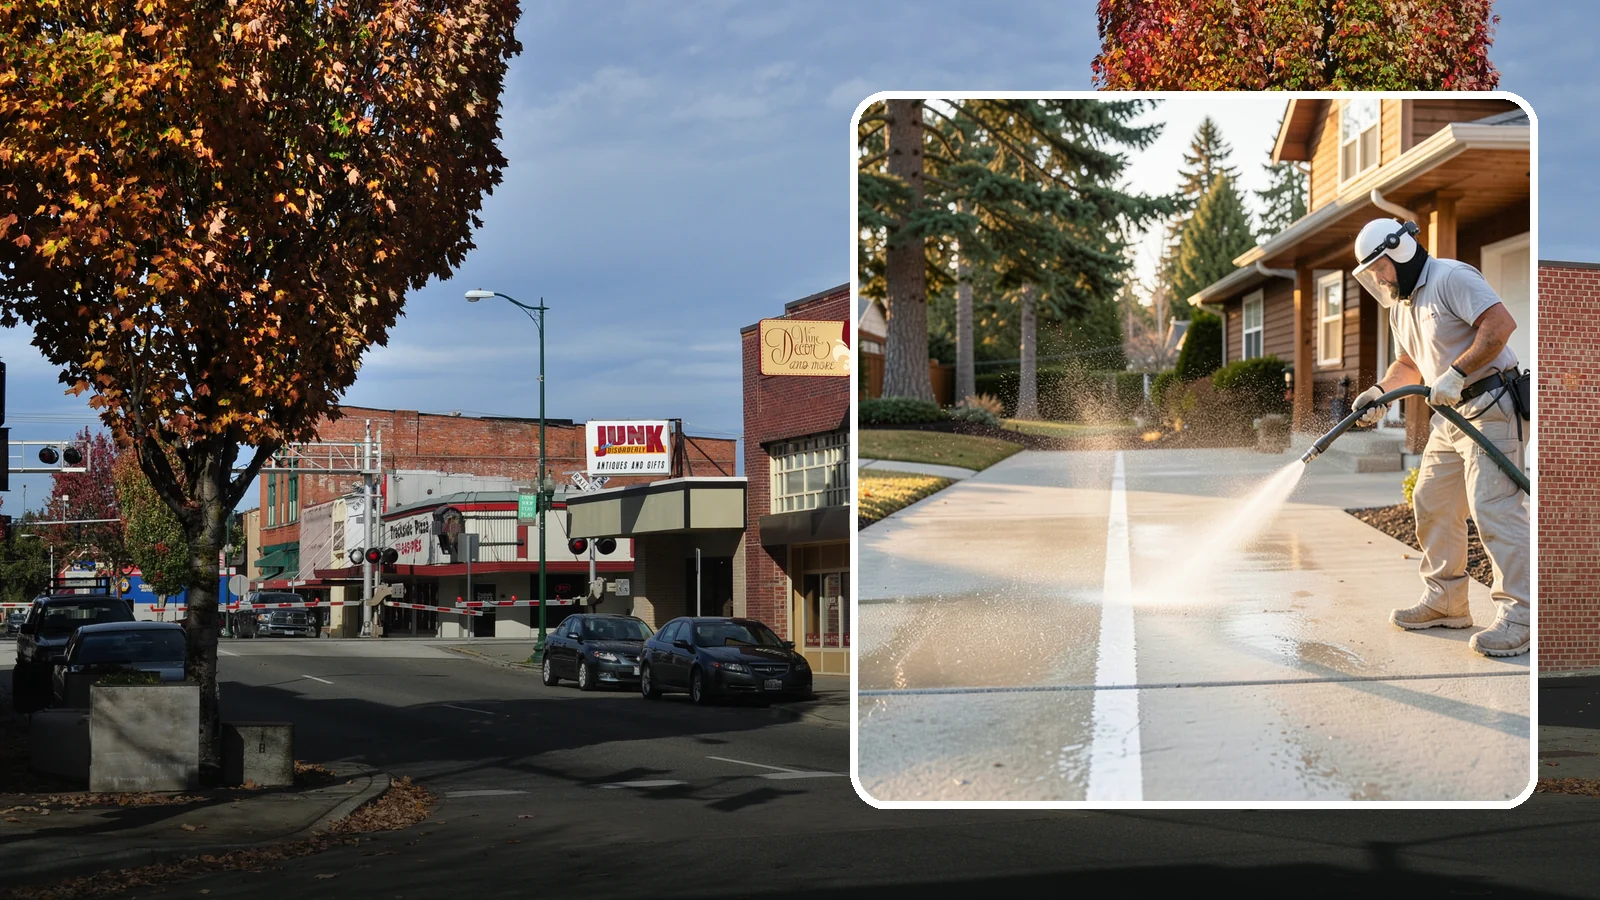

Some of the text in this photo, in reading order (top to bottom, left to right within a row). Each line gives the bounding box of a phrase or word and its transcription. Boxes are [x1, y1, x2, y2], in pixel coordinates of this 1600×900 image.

[595, 425, 666, 457] JUNK
[607, 446, 646, 454] DISORDERLY
[596, 460, 666, 470] ANTIQUES AND GIFTS
[390, 519, 429, 540] Trackside Pizza
